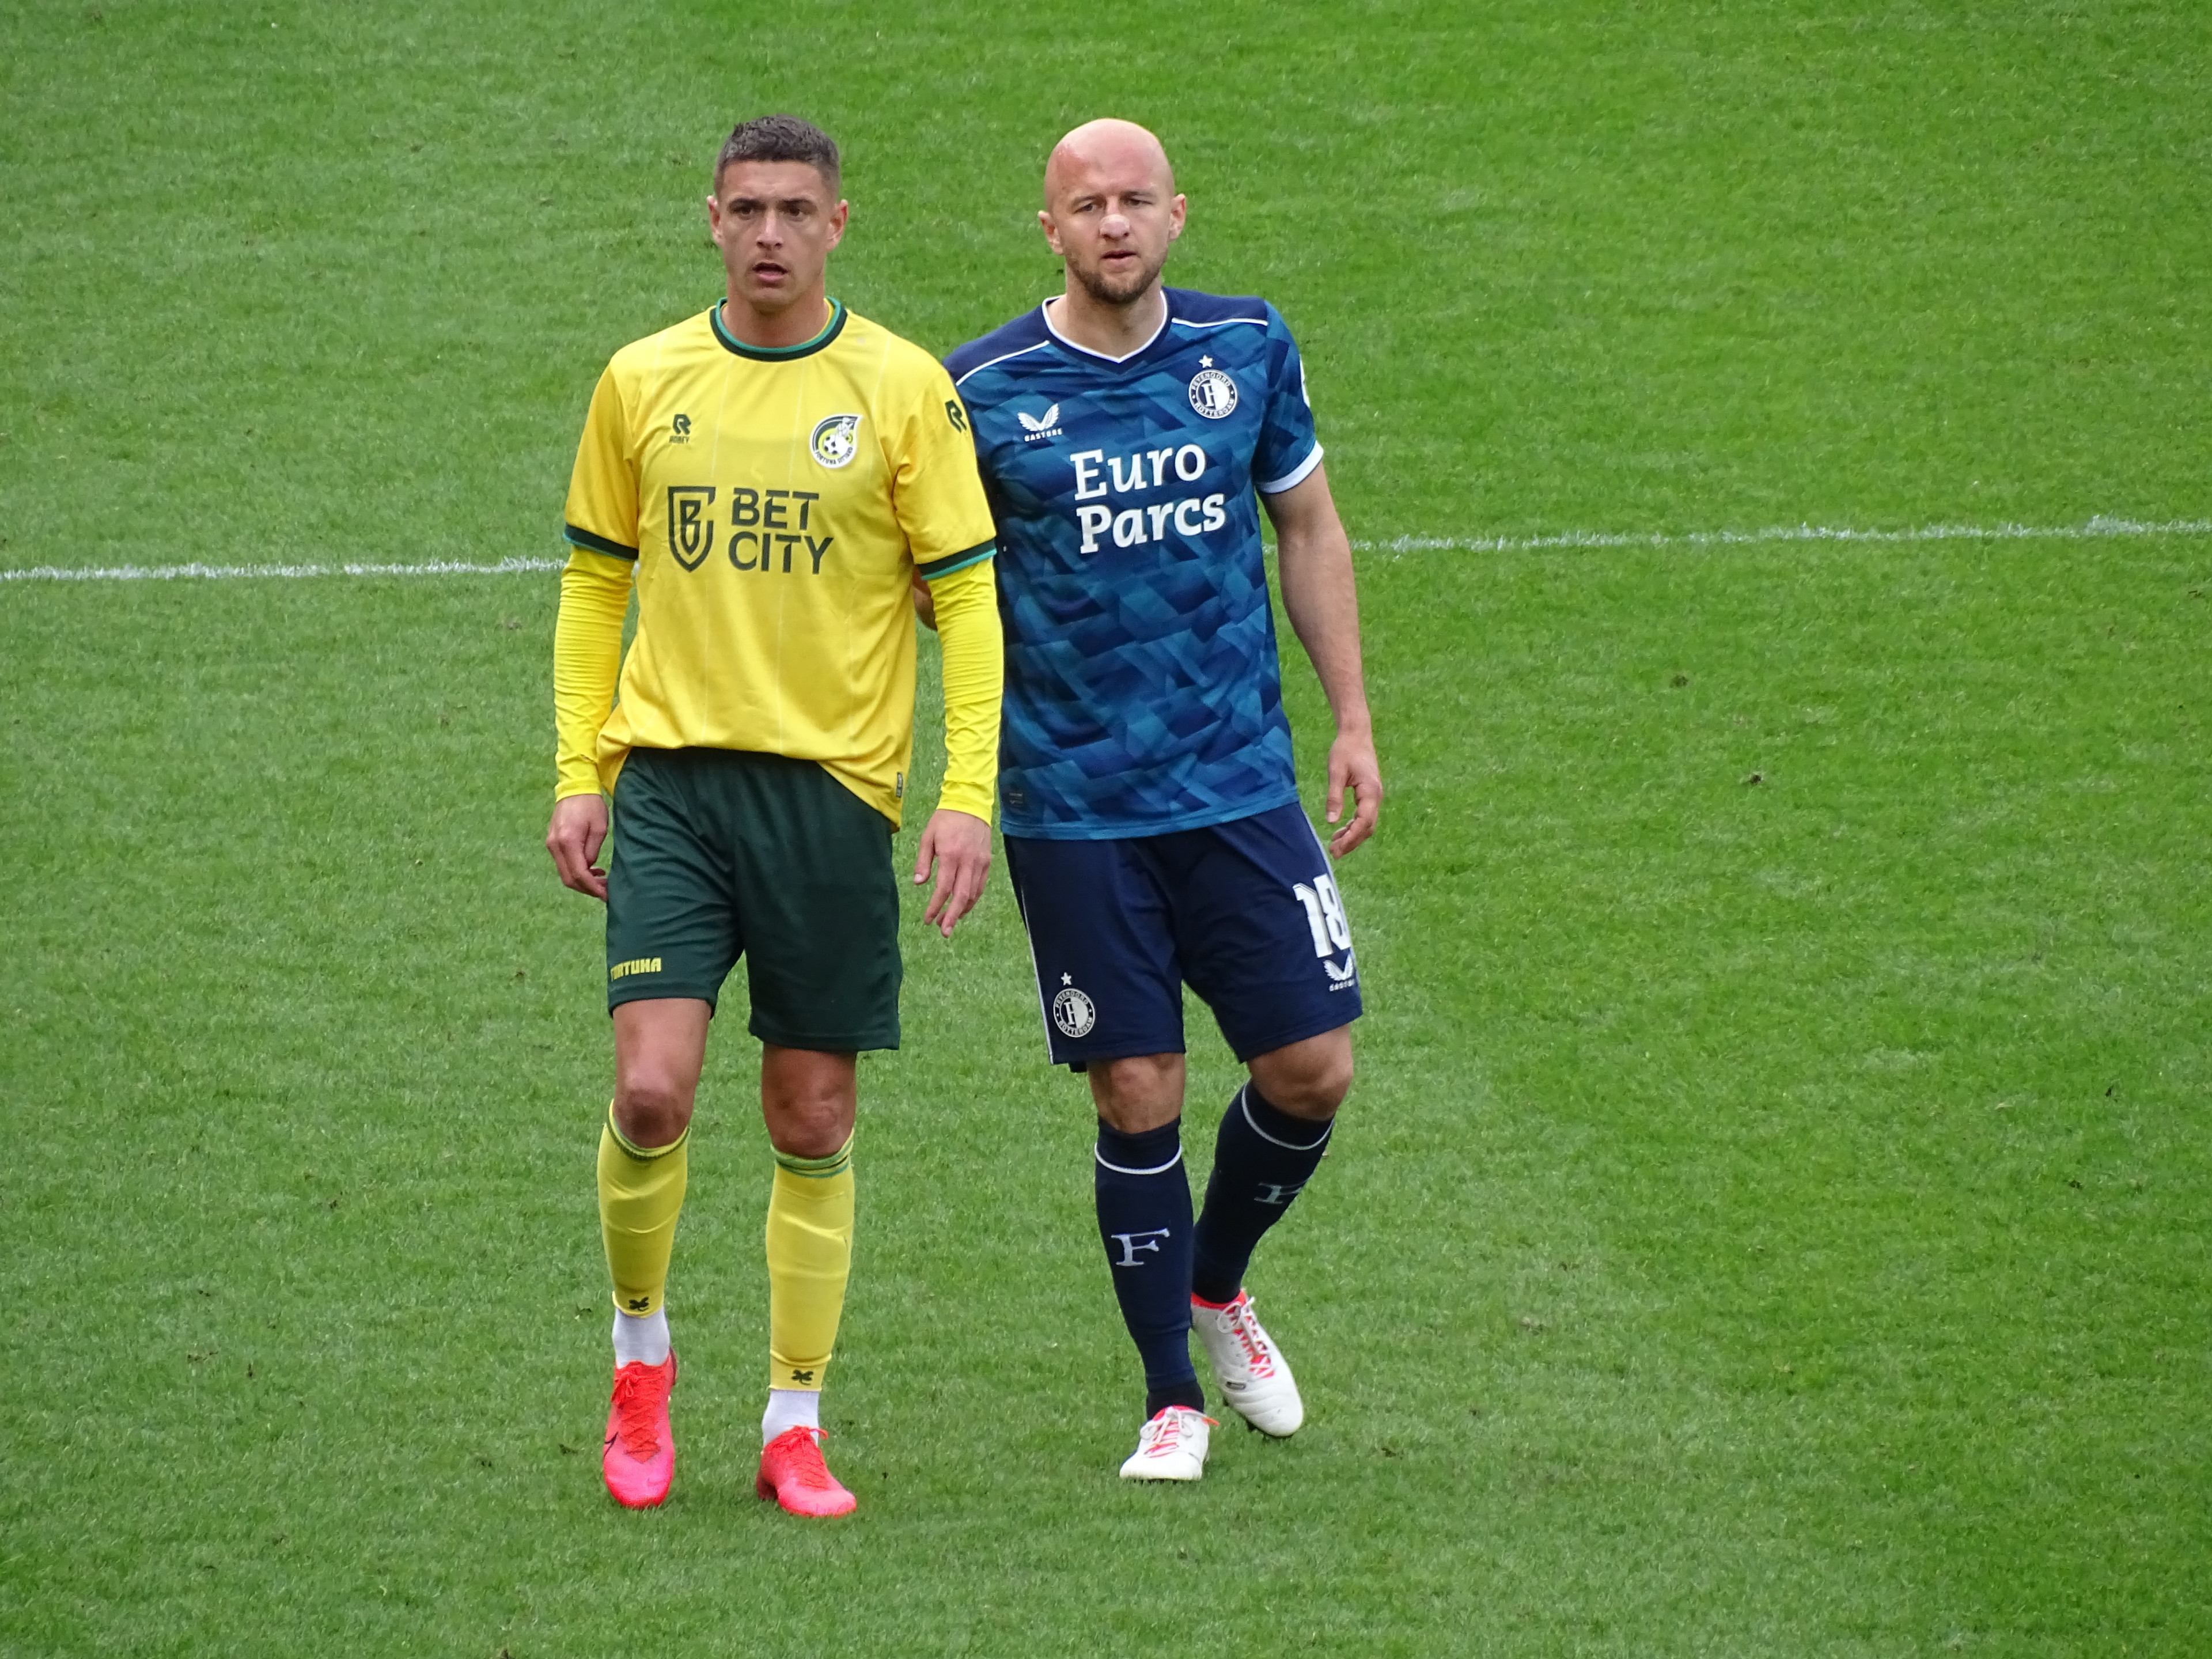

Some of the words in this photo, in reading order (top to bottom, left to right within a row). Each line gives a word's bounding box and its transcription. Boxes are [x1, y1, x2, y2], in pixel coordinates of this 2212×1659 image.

[1070, 444, 1206, 501] Euro
[732, 487, 819, 531] BET
[1076, 493, 1226, 554] Parcs
[728, 531, 834, 574] CITY
[1292, 873, 1351, 958] 18
[1111, 1228, 1171, 1267] F
